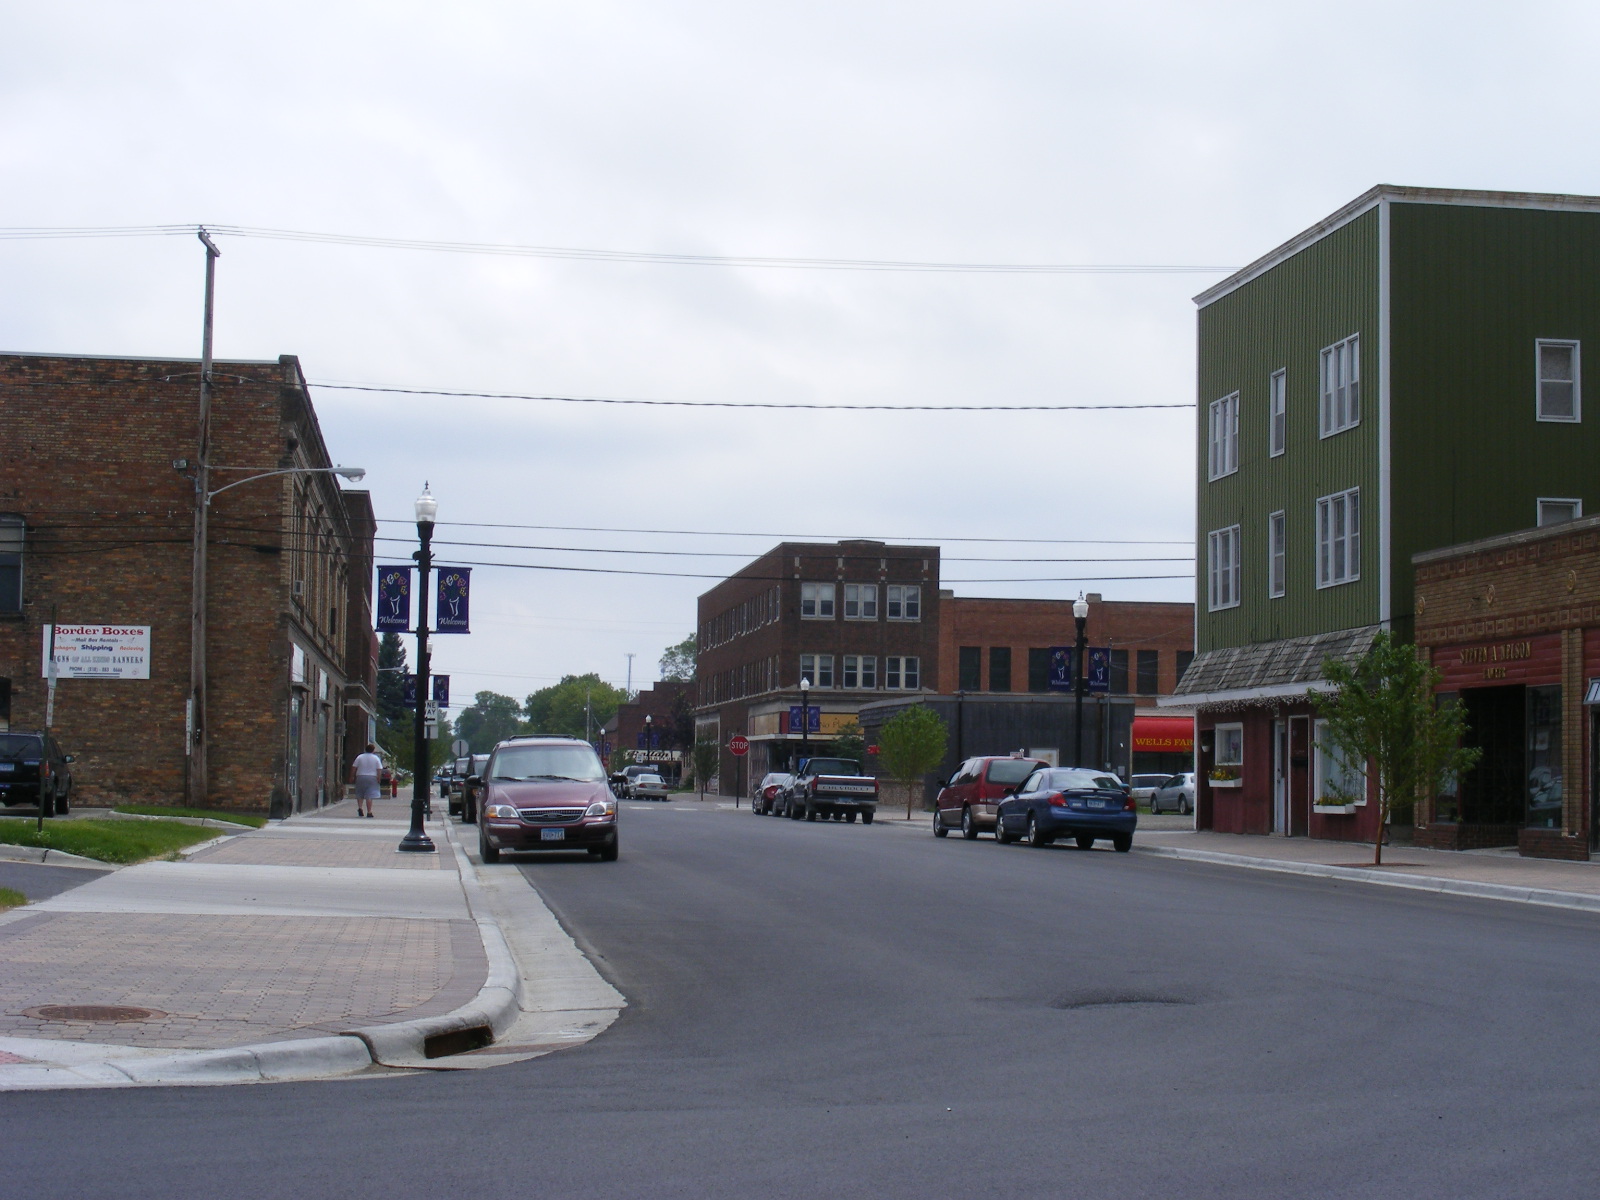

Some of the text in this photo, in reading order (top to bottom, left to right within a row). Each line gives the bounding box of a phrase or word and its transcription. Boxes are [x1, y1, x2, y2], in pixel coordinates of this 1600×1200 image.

[379, 614, 408, 624] Welcome
[438, 616, 467, 626] Welcome
[54, 626, 144, 636] Border Boxes
[81, 644, 114, 652] Shipping
[1459, 641, 1532, 664] STEVEN A NELSON
[54, 655, 70, 663] IGNS
[113, 656, 144, 664] BANNERS
[426, 701, 436, 709] NE
[731, 741, 749, 750] STOP
[1135, 738, 1193, 746] WELLS FAR
